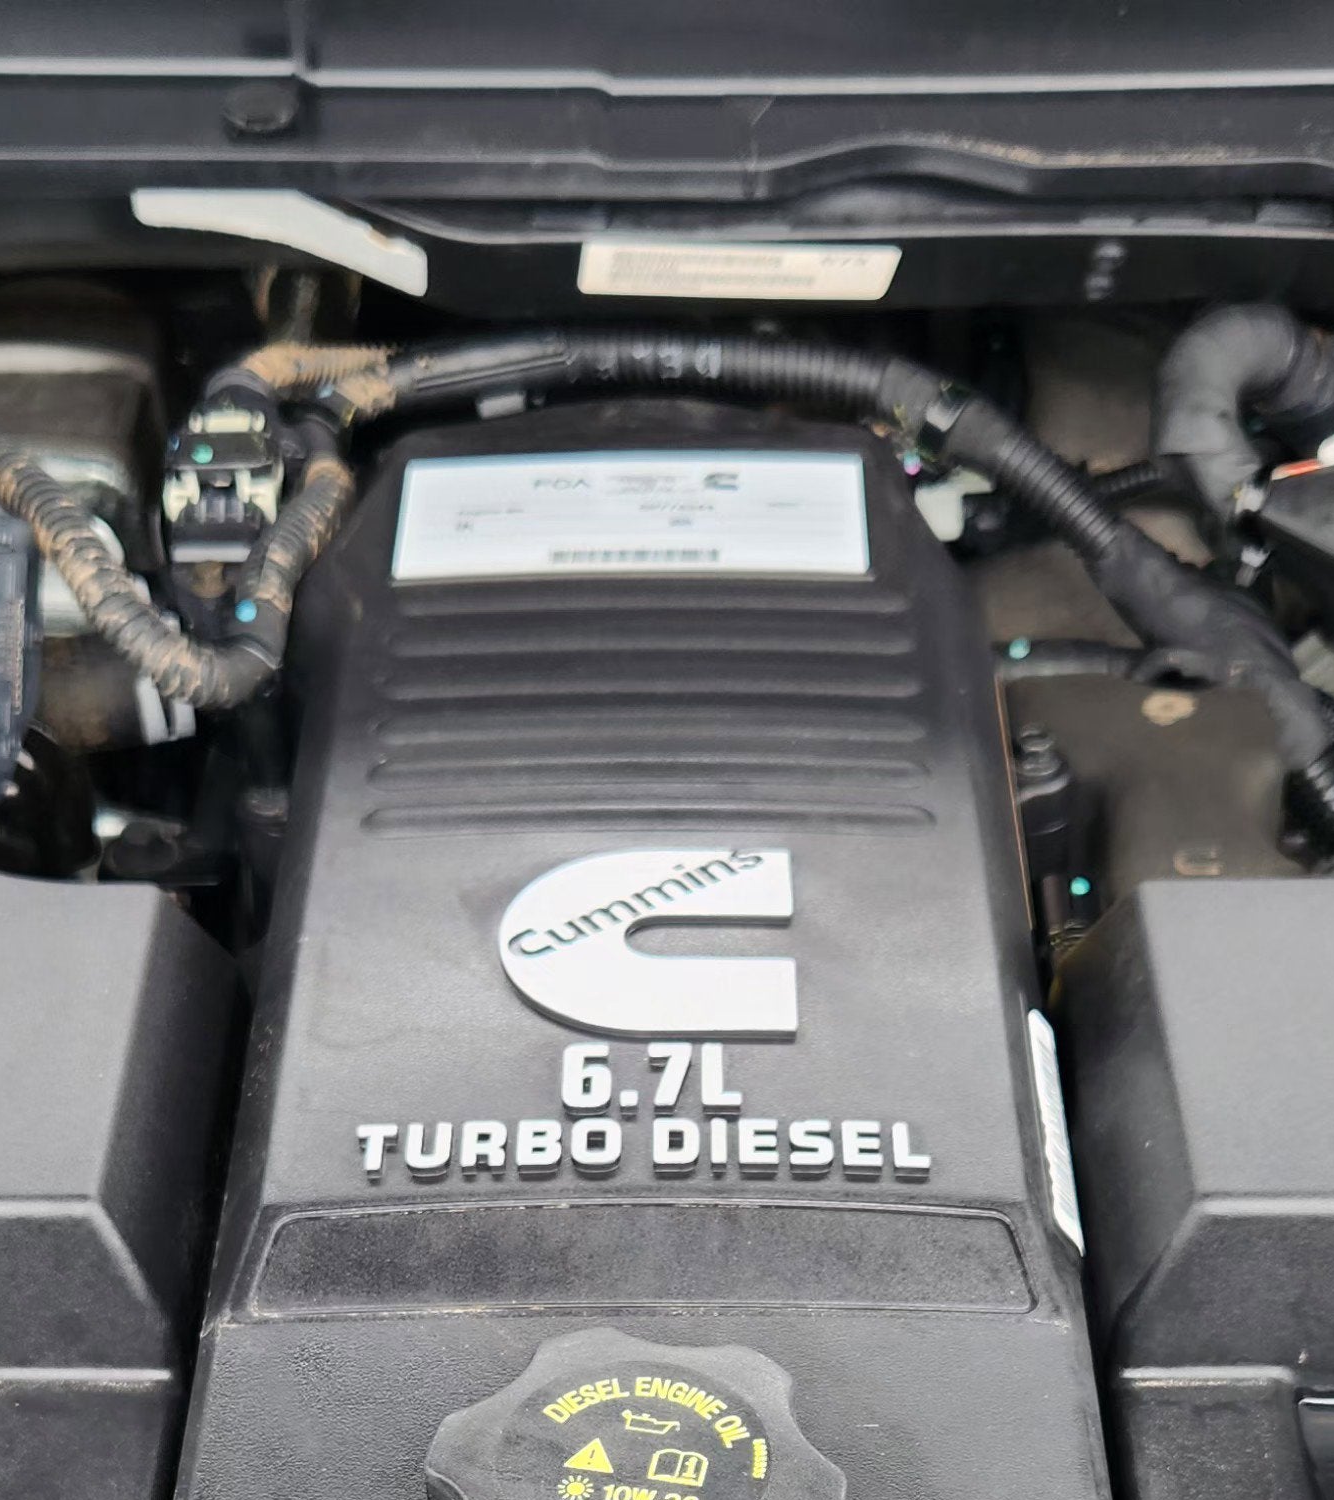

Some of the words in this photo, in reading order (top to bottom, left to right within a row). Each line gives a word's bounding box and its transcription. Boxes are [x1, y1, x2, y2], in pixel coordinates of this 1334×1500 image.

[507, 848, 765, 956] Cummins
[559, 1041, 744, 1112] 6.7L
[355, 1117, 624, 1174] TURBO
[651, 1117, 933, 1174] DIESEL
[543, 1378, 629, 1425] DIESEL
[634, 1376, 728, 1420] ENGINE
[714, 1412, 752, 1449] OIL
